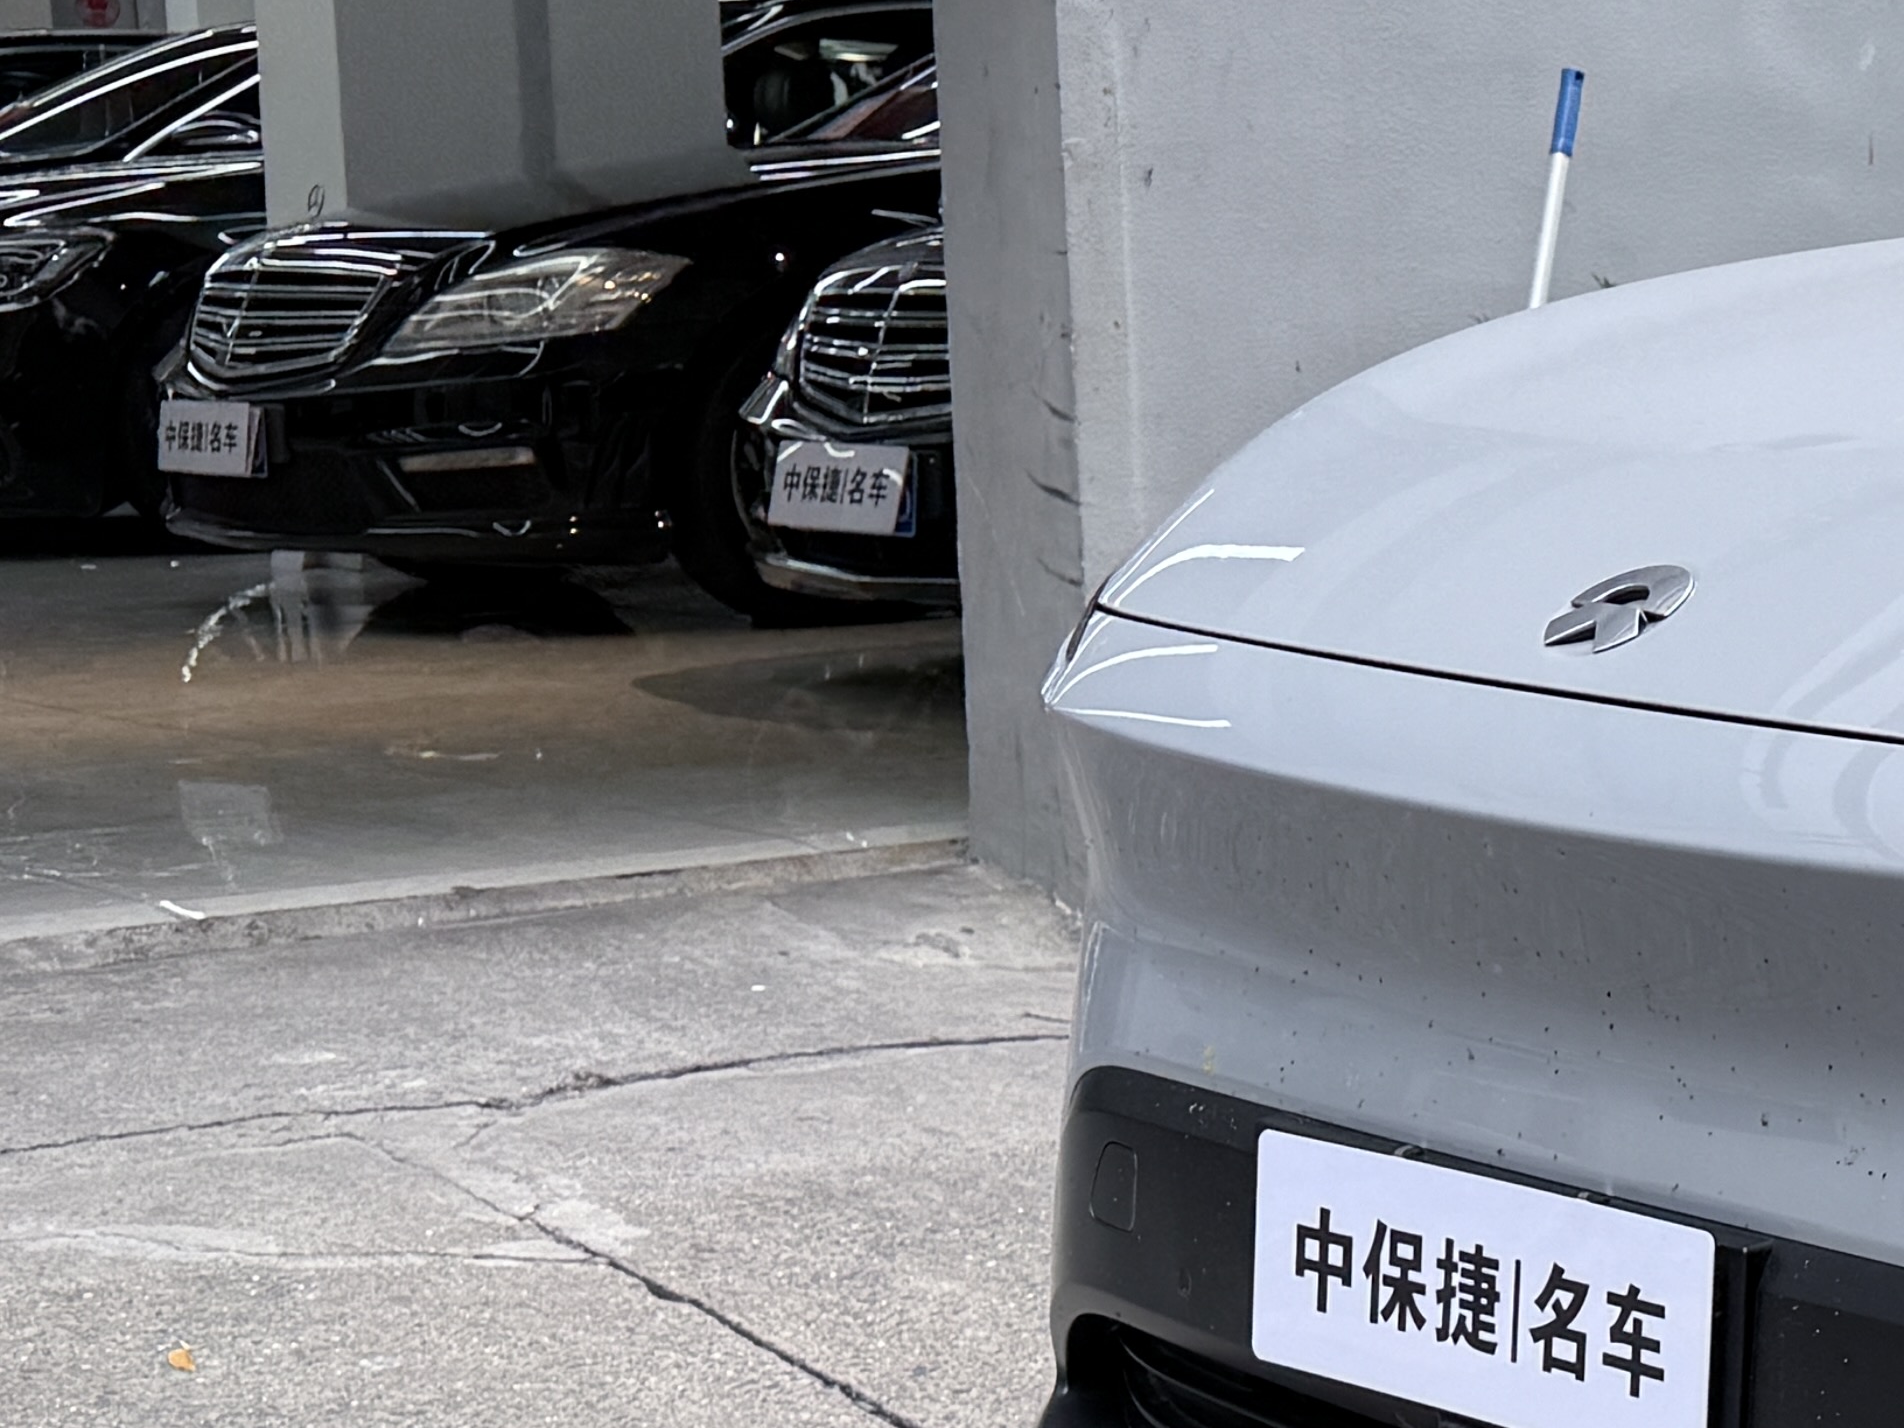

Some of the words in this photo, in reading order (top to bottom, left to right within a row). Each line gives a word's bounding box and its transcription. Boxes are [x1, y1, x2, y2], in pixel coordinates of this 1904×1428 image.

[1295, 1207, 1667, 1398] 中保捷|名车
